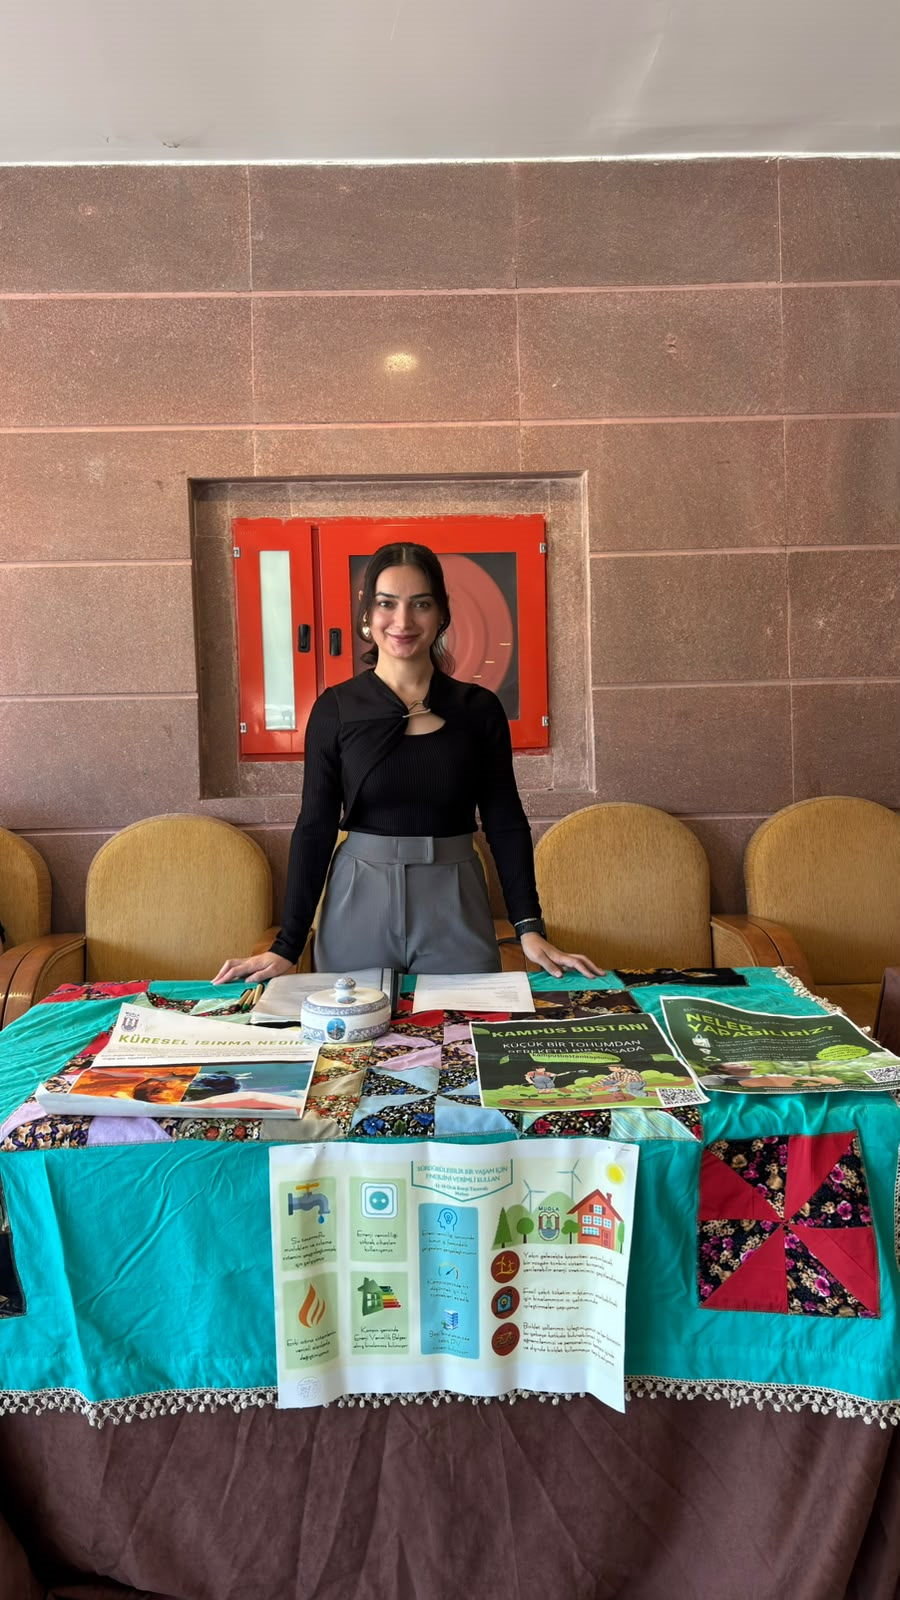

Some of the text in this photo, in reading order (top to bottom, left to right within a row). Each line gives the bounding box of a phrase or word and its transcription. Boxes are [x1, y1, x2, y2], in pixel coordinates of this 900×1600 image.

[686, 1013, 753, 1031] NELER
[571, 1023, 649, 1033] BOSTANI
[118, 1033, 189, 1045] KÜRESEL
[503, 1041, 544, 1049] KÜÇÜK
[569, 1040, 641, 1048] TOHUMDAN
